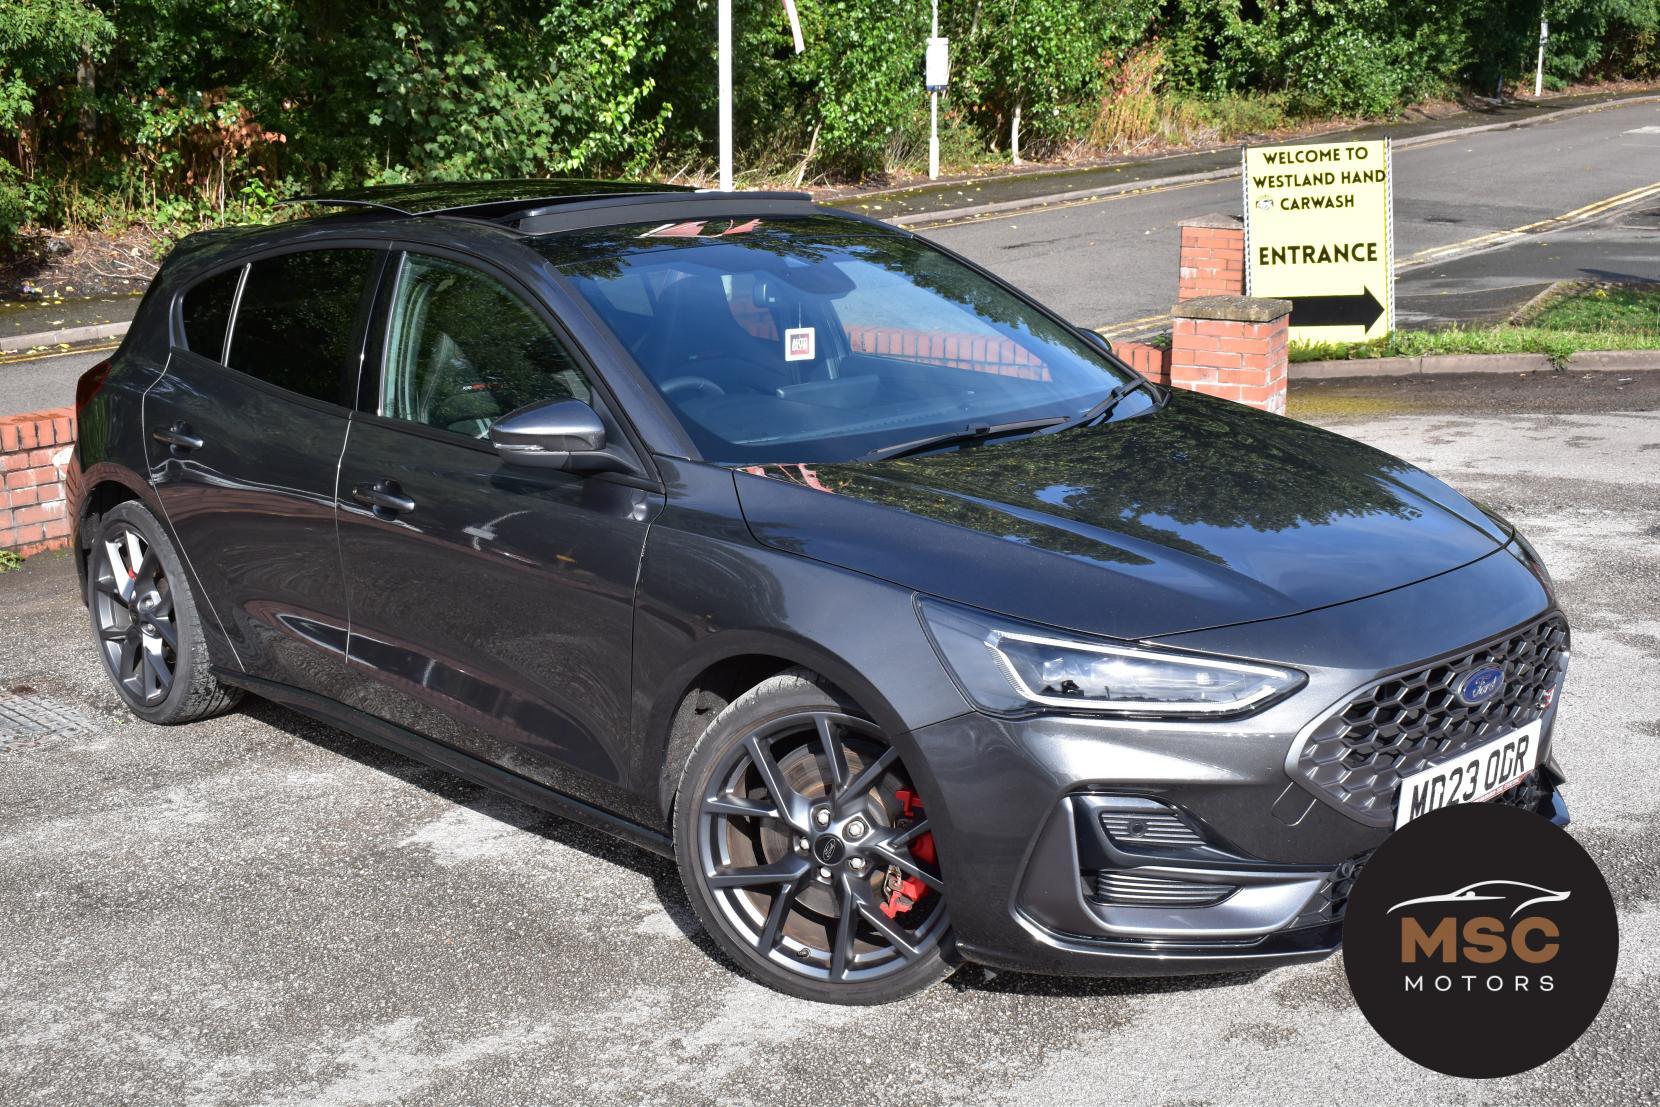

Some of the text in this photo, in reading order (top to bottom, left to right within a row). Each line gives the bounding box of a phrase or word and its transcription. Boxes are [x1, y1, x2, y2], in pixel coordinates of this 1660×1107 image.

[1263, 147, 1368, 165] WELCOME TO
[1253, 170, 1386, 188] WESTLAND HAND
[1280, 194, 1355, 210] CARWASH
[1259, 243, 1378, 266] ENTRANCE
[1472, 676, 1497, 698] Ford
